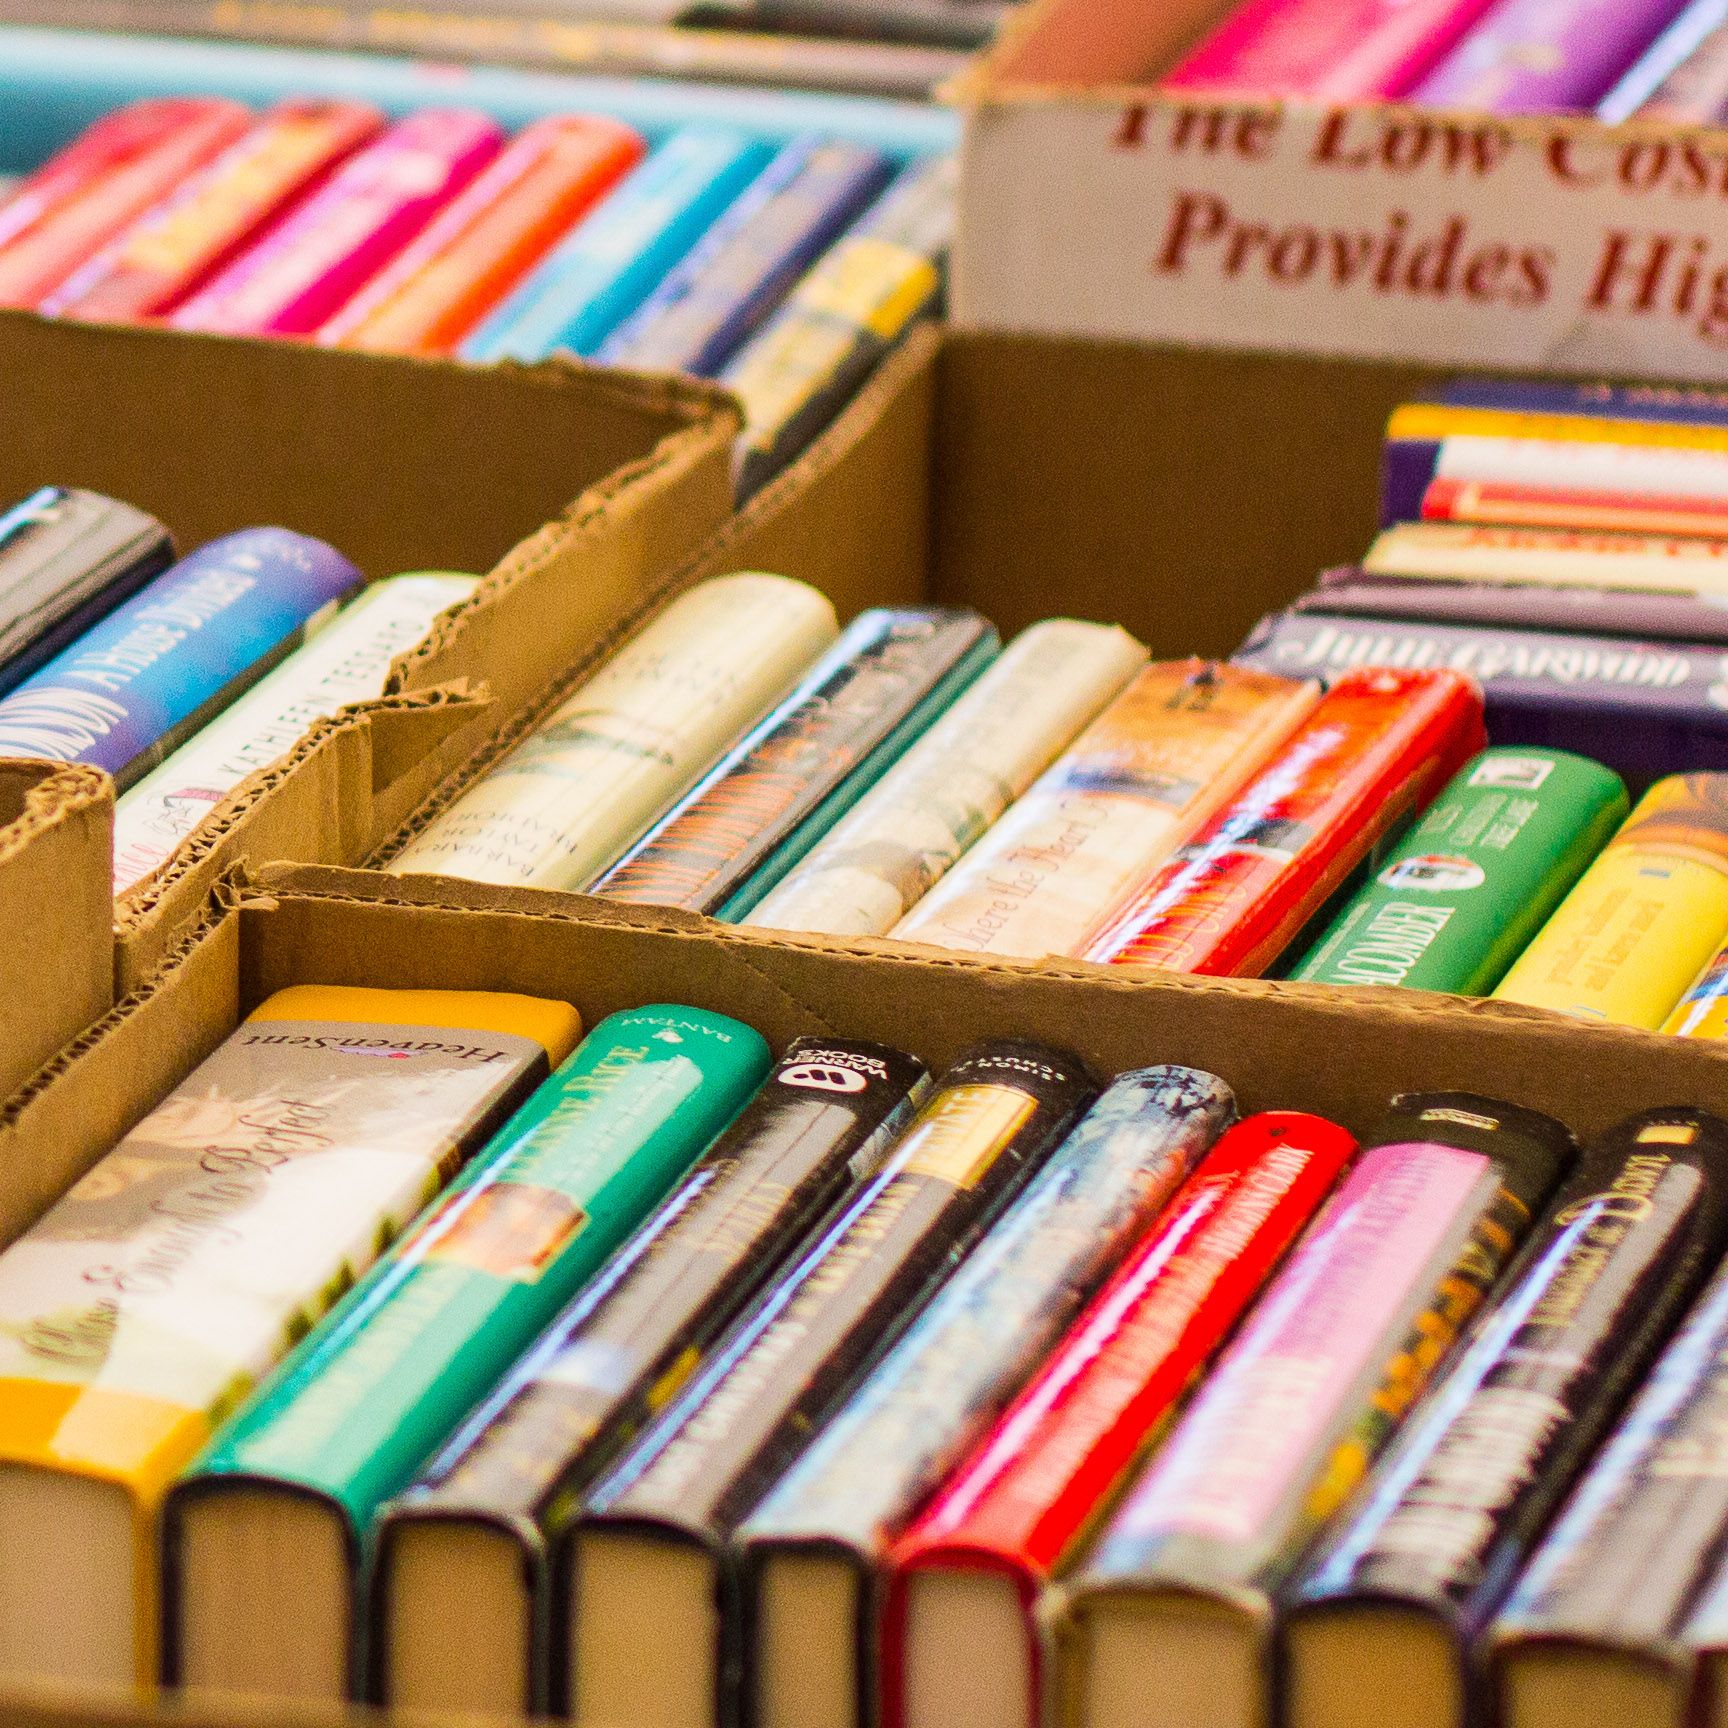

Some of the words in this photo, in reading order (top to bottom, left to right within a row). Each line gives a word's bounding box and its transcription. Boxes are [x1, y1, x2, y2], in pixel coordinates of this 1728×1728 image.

[1155, 190, 1554, 309] Provides
[622, 1017, 734, 1045] BANTAM
[782, 1055, 889, 1080] WARNER
[797, 1048, 887, 1068] BOOKS
[197, 1097, 338, 1175] Perfect
